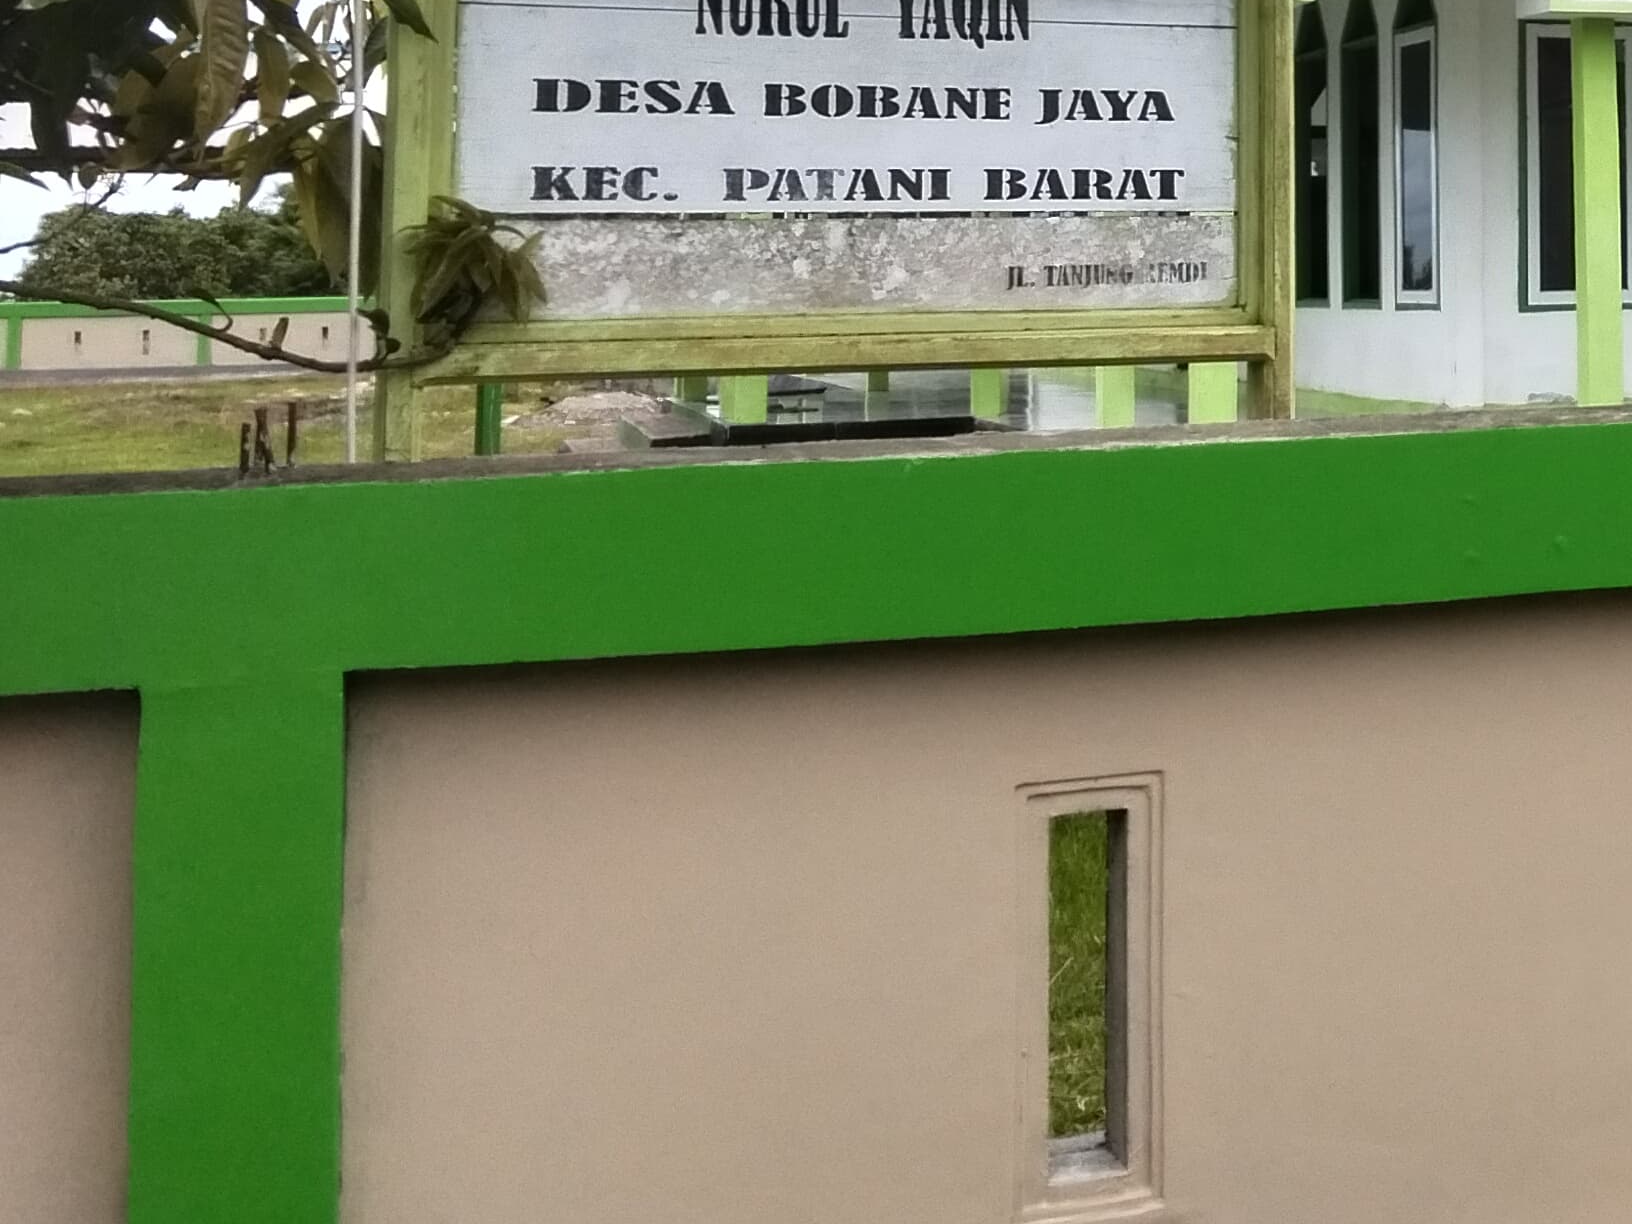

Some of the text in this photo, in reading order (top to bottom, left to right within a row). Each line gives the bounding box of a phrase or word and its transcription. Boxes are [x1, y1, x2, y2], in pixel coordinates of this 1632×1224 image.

[532, 78, 1175, 125] DESA BOBANE JAYA
[530, 165, 1185, 202] KEC. PATANI BARAT
[1007, 265, 1036, 290] JL.
[1044, 263, 1134, 288] TANJUNG
